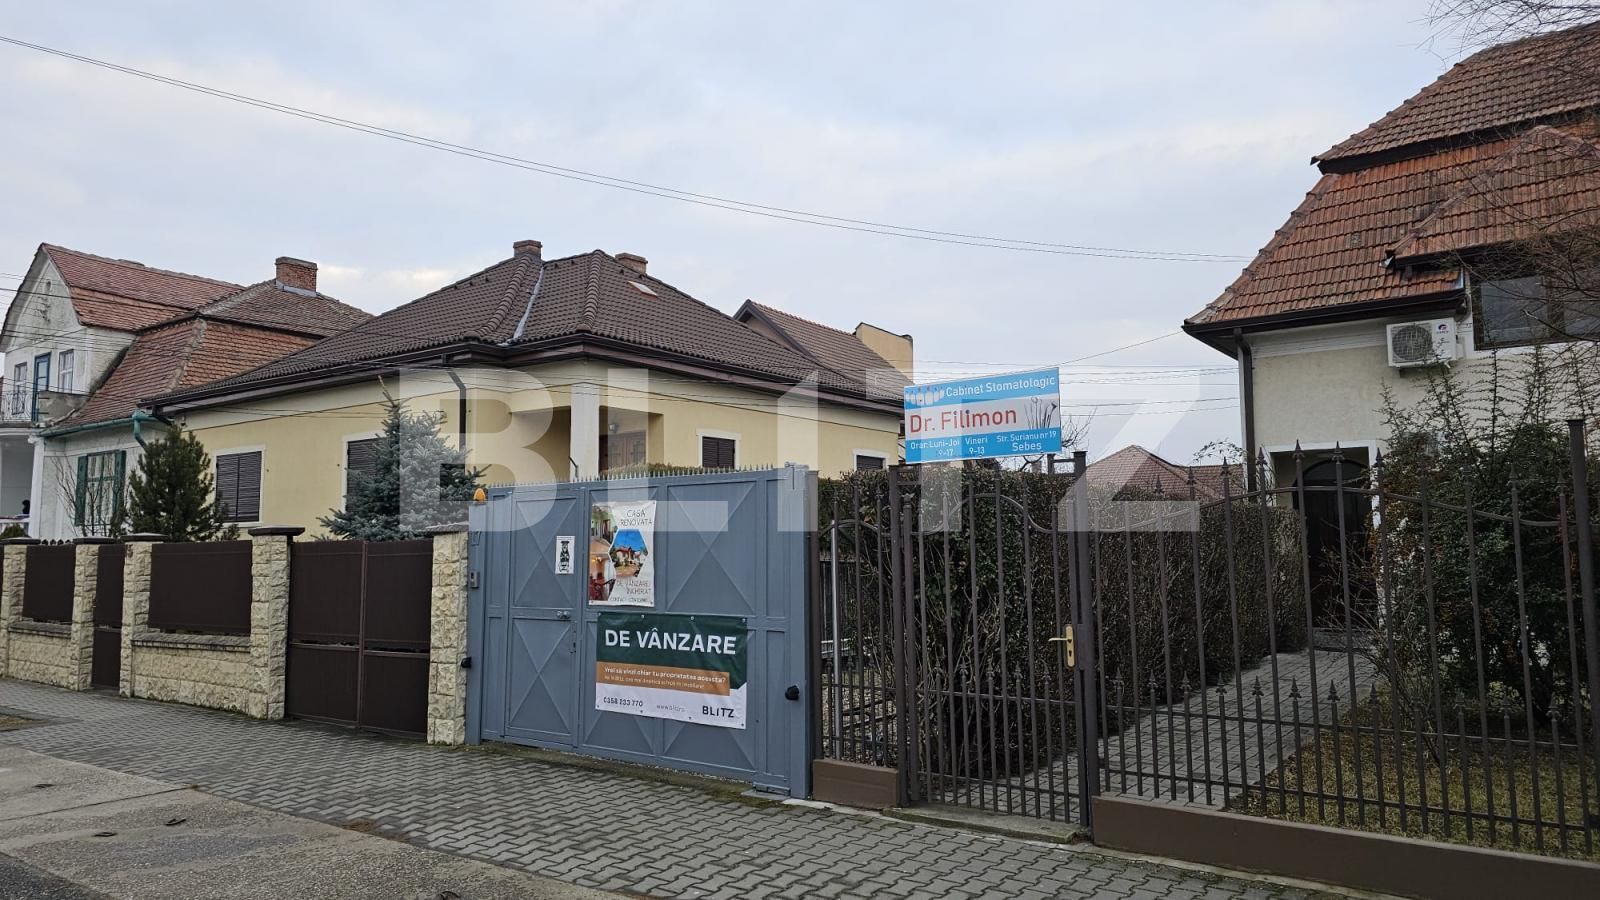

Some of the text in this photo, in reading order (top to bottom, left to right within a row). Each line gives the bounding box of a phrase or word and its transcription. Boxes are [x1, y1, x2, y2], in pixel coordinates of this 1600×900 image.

[946, 376, 1055, 397] Cabinet Stomatologic
[910, 409, 1017, 433] Dr. Filimon
[965, 436, 988, 445] Vineri
[996, 435, 1009, 443] Str.
[1040, 431, 1048, 439] nr
[1049, 430, 1057, 438] 19
[930, 440, 960, 448] Luni-Joi
[969, 446, 985, 454] 9-13
[626, 509, 646, 518] CASA
[605, 627, 737, 655] DE VÂNZARE
[702, 705, 735, 718] BLITZ
